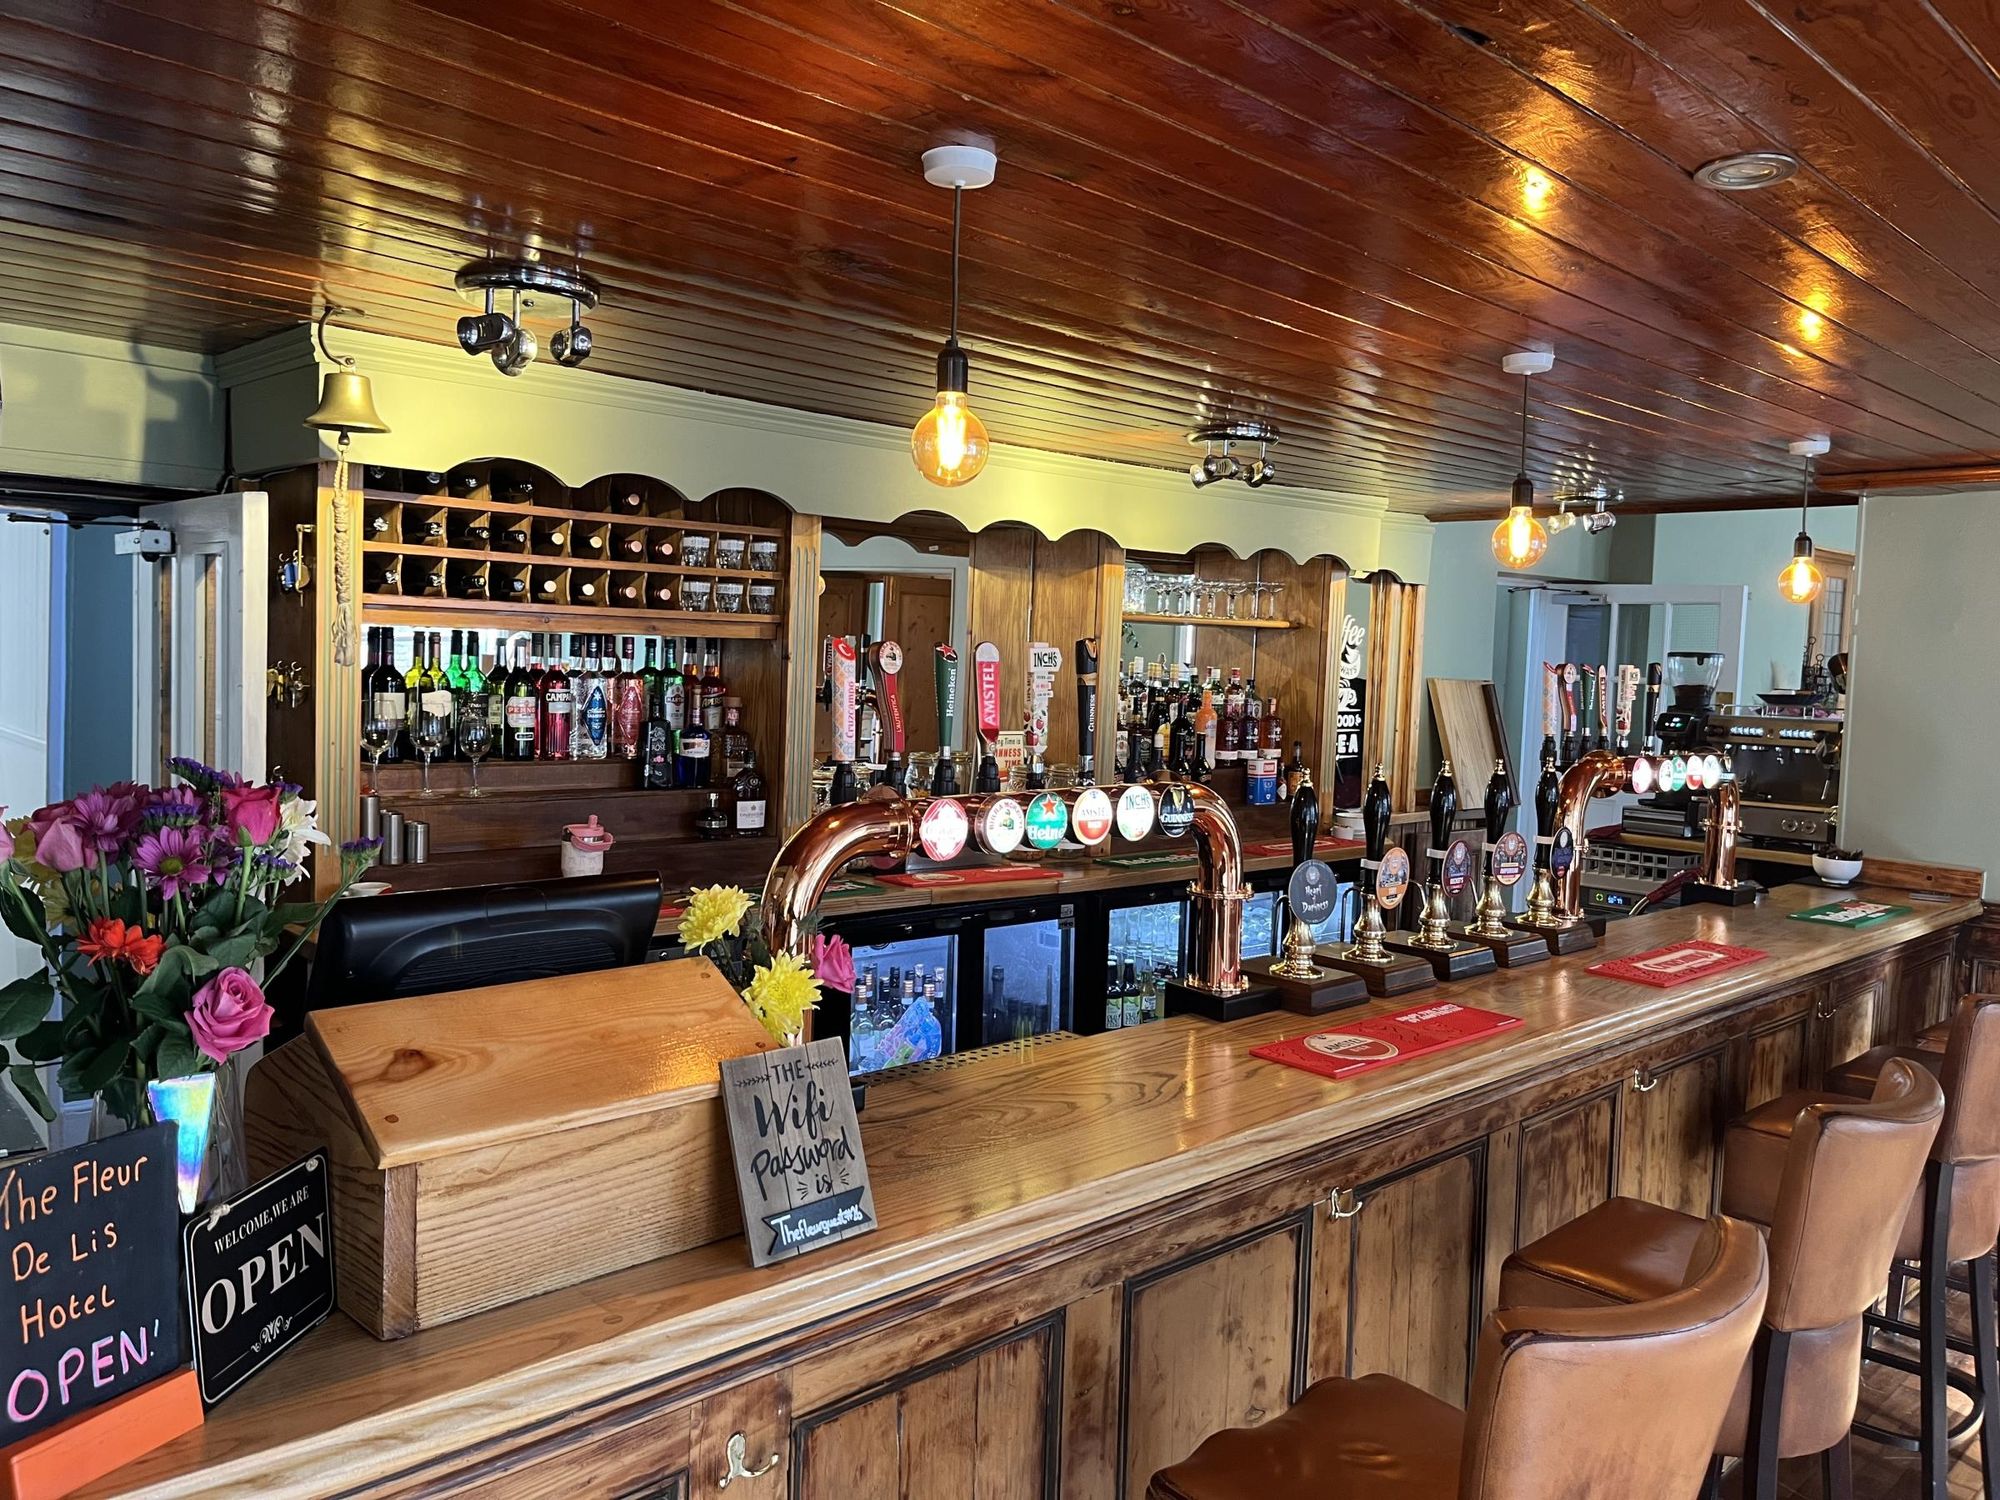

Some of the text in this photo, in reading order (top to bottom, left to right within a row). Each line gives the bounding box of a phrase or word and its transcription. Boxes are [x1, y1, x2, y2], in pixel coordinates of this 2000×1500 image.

[1341, 614, 1366, 653] ffee
[845, 680, 856, 739] Cruzcampo
[945, 667, 957, 718] Heineken
[983, 662, 996, 726] AMSTEL
[1088, 693, 1097, 733] GUINNESS
[1337, 714, 1356, 728] OOD
[1027, 824, 1067, 840] Heine
[770, 1059, 805, 1085] THE
[753, 1080, 835, 1140] Wifi
[750, 1125, 856, 1202] Password
[815, 1173, 834, 1195] is
[0, 1156, 148, 1231] The Fleur
[272, 1198, 289, 1219] WE
[290, 1184, 310, 1209] ARE
[12, 1222, 118, 1282] De Lis
[201, 1211, 326, 1335] OPEN
[20, 1284, 116, 1345] Hotel
[7, 1318, 160, 1424] OPEN!
